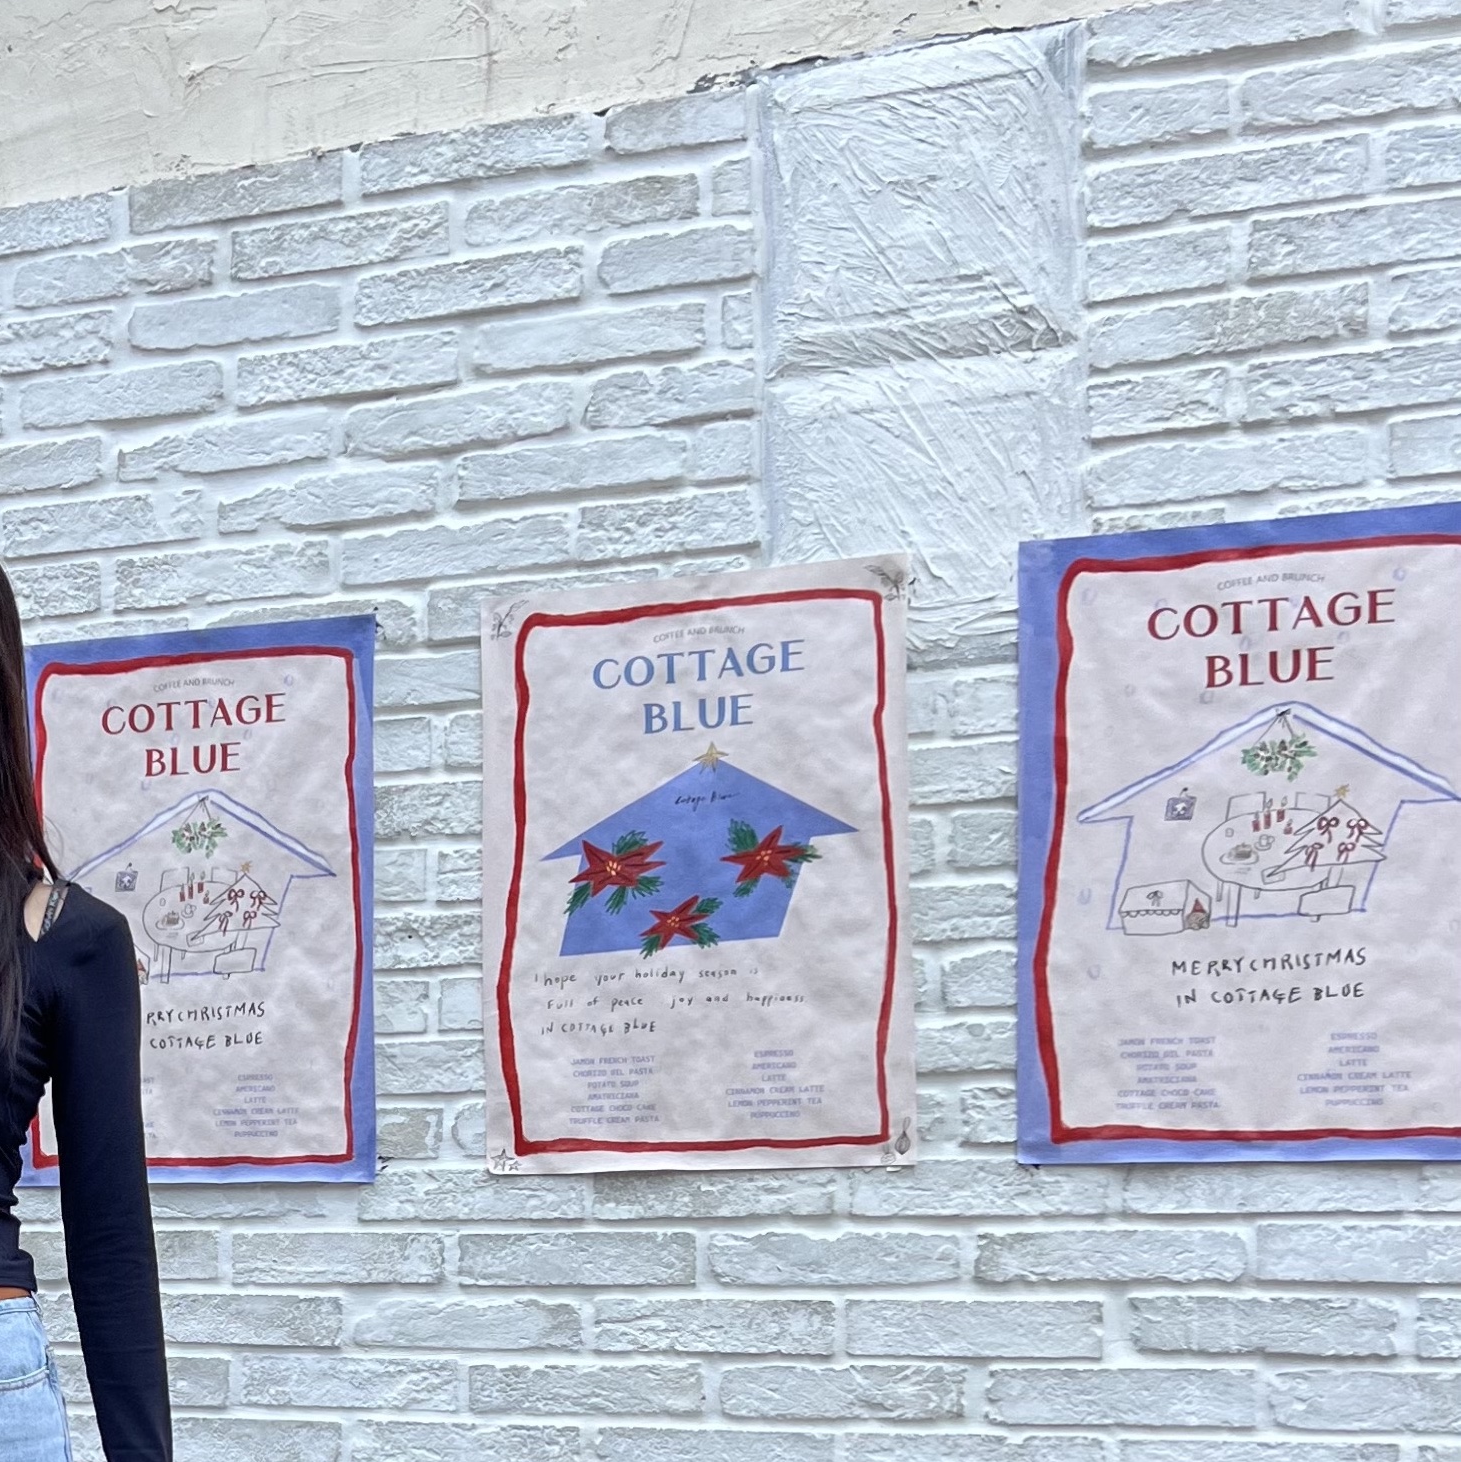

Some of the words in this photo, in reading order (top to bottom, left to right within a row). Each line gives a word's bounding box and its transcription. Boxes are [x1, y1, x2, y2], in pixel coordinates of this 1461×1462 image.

[1217, 577, 1252, 591] COFFEE
[1256, 573, 1279, 582] AND
[1282, 572, 1325, 583] BRUNCH
[1147, 588, 1396, 640] COTTAGE
[653, 629, 685, 643] COFFEE
[687, 626, 707, 636] AND
[708, 625, 745, 635] BRUNCH
[592, 639, 805, 690] COTTAGE
[1205, 646, 1335, 689] BLUE
[183, 678, 201, 686] AND
[101, 692, 286, 735] COTTAGE
[642, 693, 754, 734] BLUE
[144, 742, 241, 778] BLUE
[543, 971, 577, 990] hope
[594, 972, 625, 987] your
[634, 965, 685, 984] holiday
[610, 996, 644, 1012] peace
[670, 996, 694, 1009] joy
[1176, 988, 1197, 1008] IN
[1210, 986, 1302, 1005] COTTAGE
[1313, 981, 1365, 1001] BLUE
[149, 1034, 216, 1050] COTTAGE
[224, 1031, 264, 1048] BLUE
[561, 1022, 614, 1037] COTTAGE
